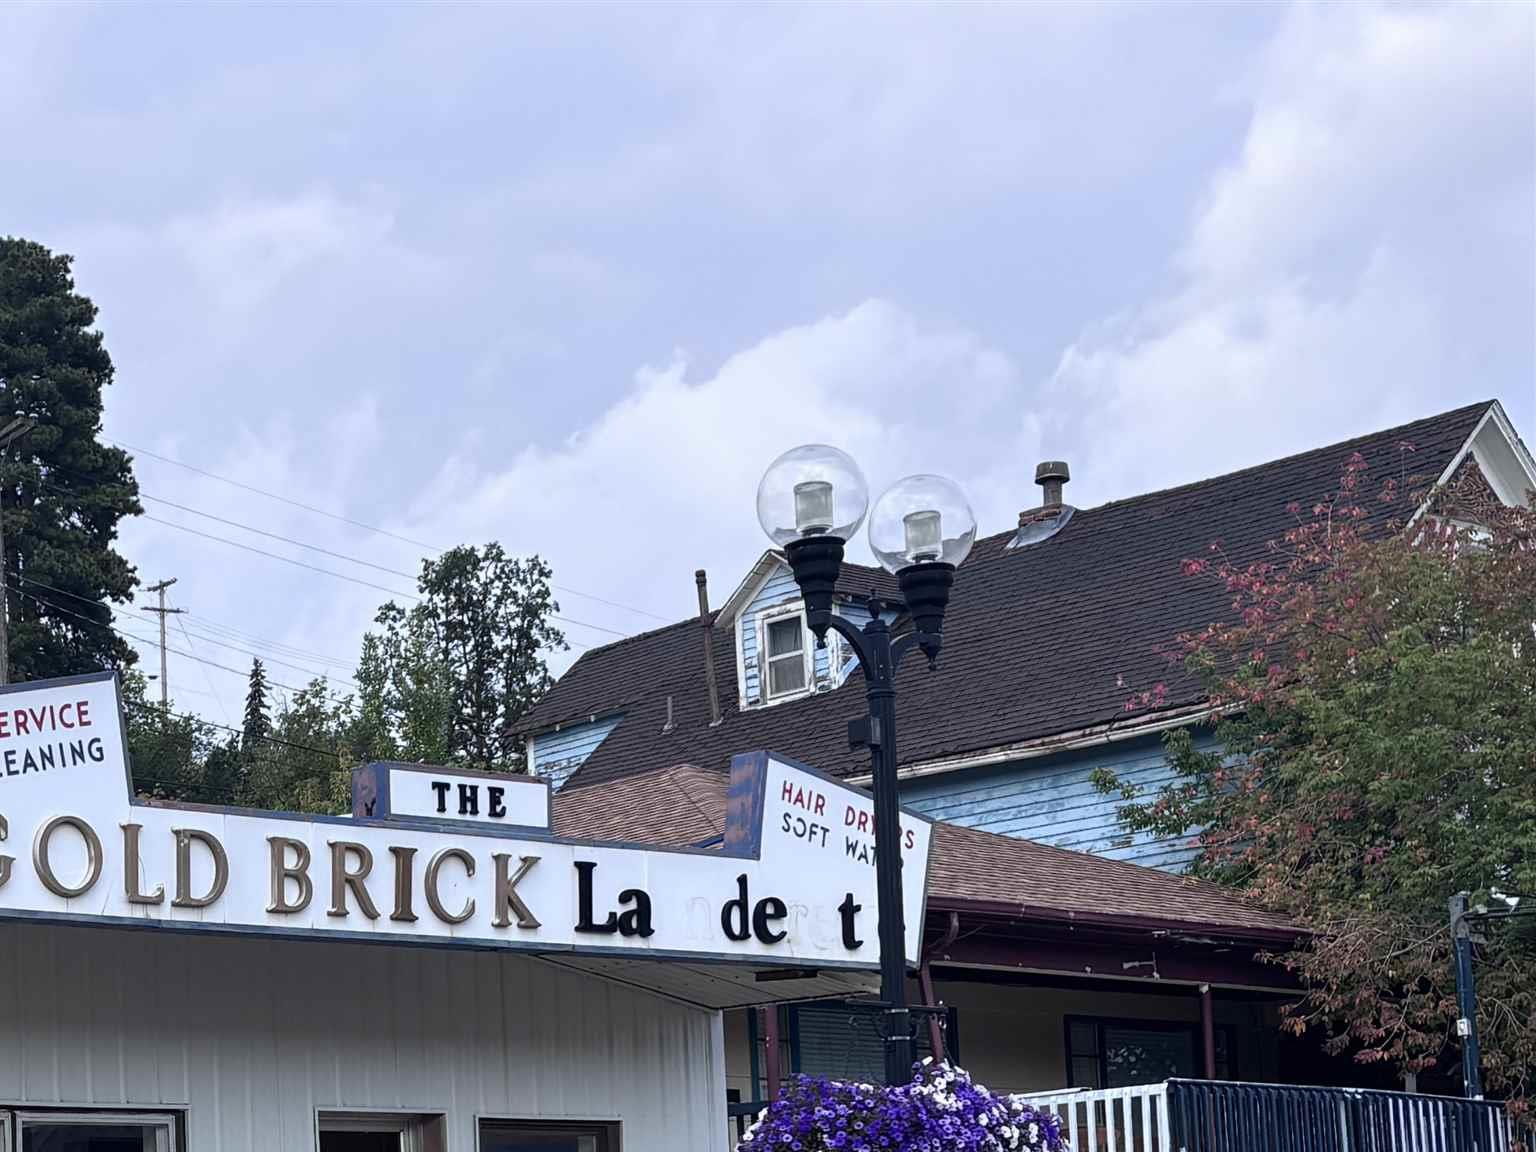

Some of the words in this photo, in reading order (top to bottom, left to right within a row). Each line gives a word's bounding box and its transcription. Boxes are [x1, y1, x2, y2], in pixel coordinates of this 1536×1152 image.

[431, 780, 507, 818] THE
[781, 779, 826, 817] HAIR
[781, 811, 830, 848] SOFT
[265, 835, 542, 930] BRICK
